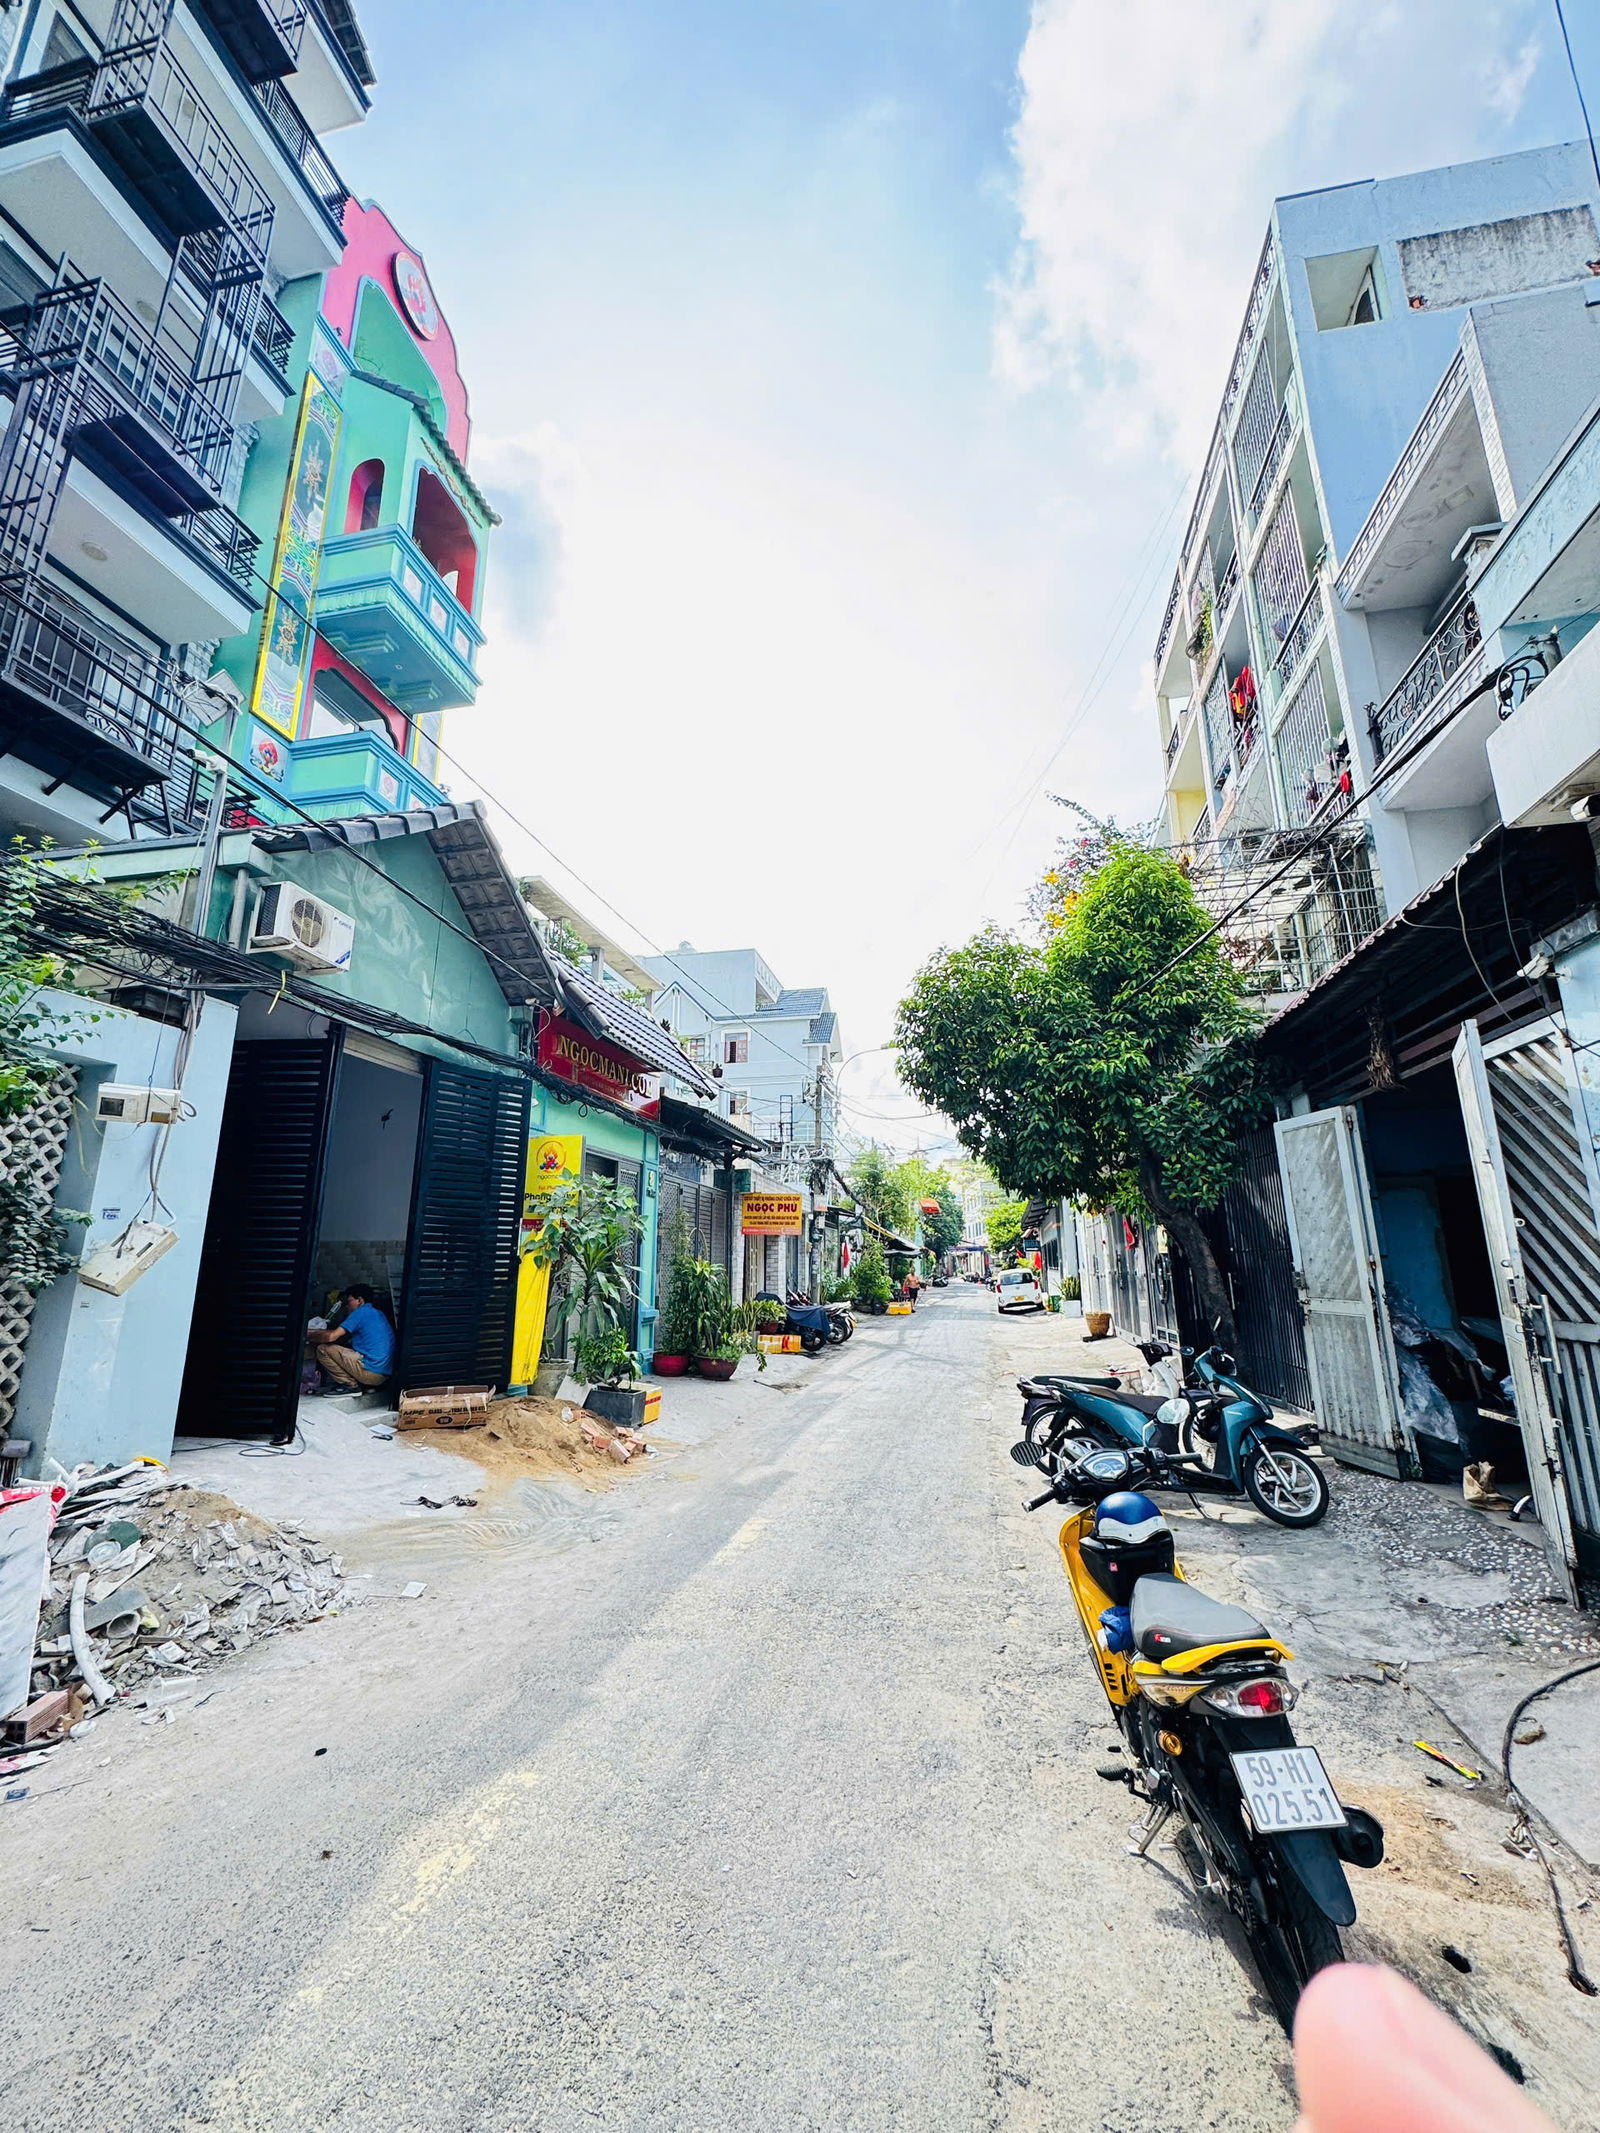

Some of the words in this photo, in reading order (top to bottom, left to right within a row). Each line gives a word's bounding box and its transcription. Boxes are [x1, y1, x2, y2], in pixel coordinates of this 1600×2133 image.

[747, 1203, 775, 1214] NGỌC
[1245, 1752, 1313, 1787] 59-H1
[1252, 1788, 1337, 1825] 025.51
